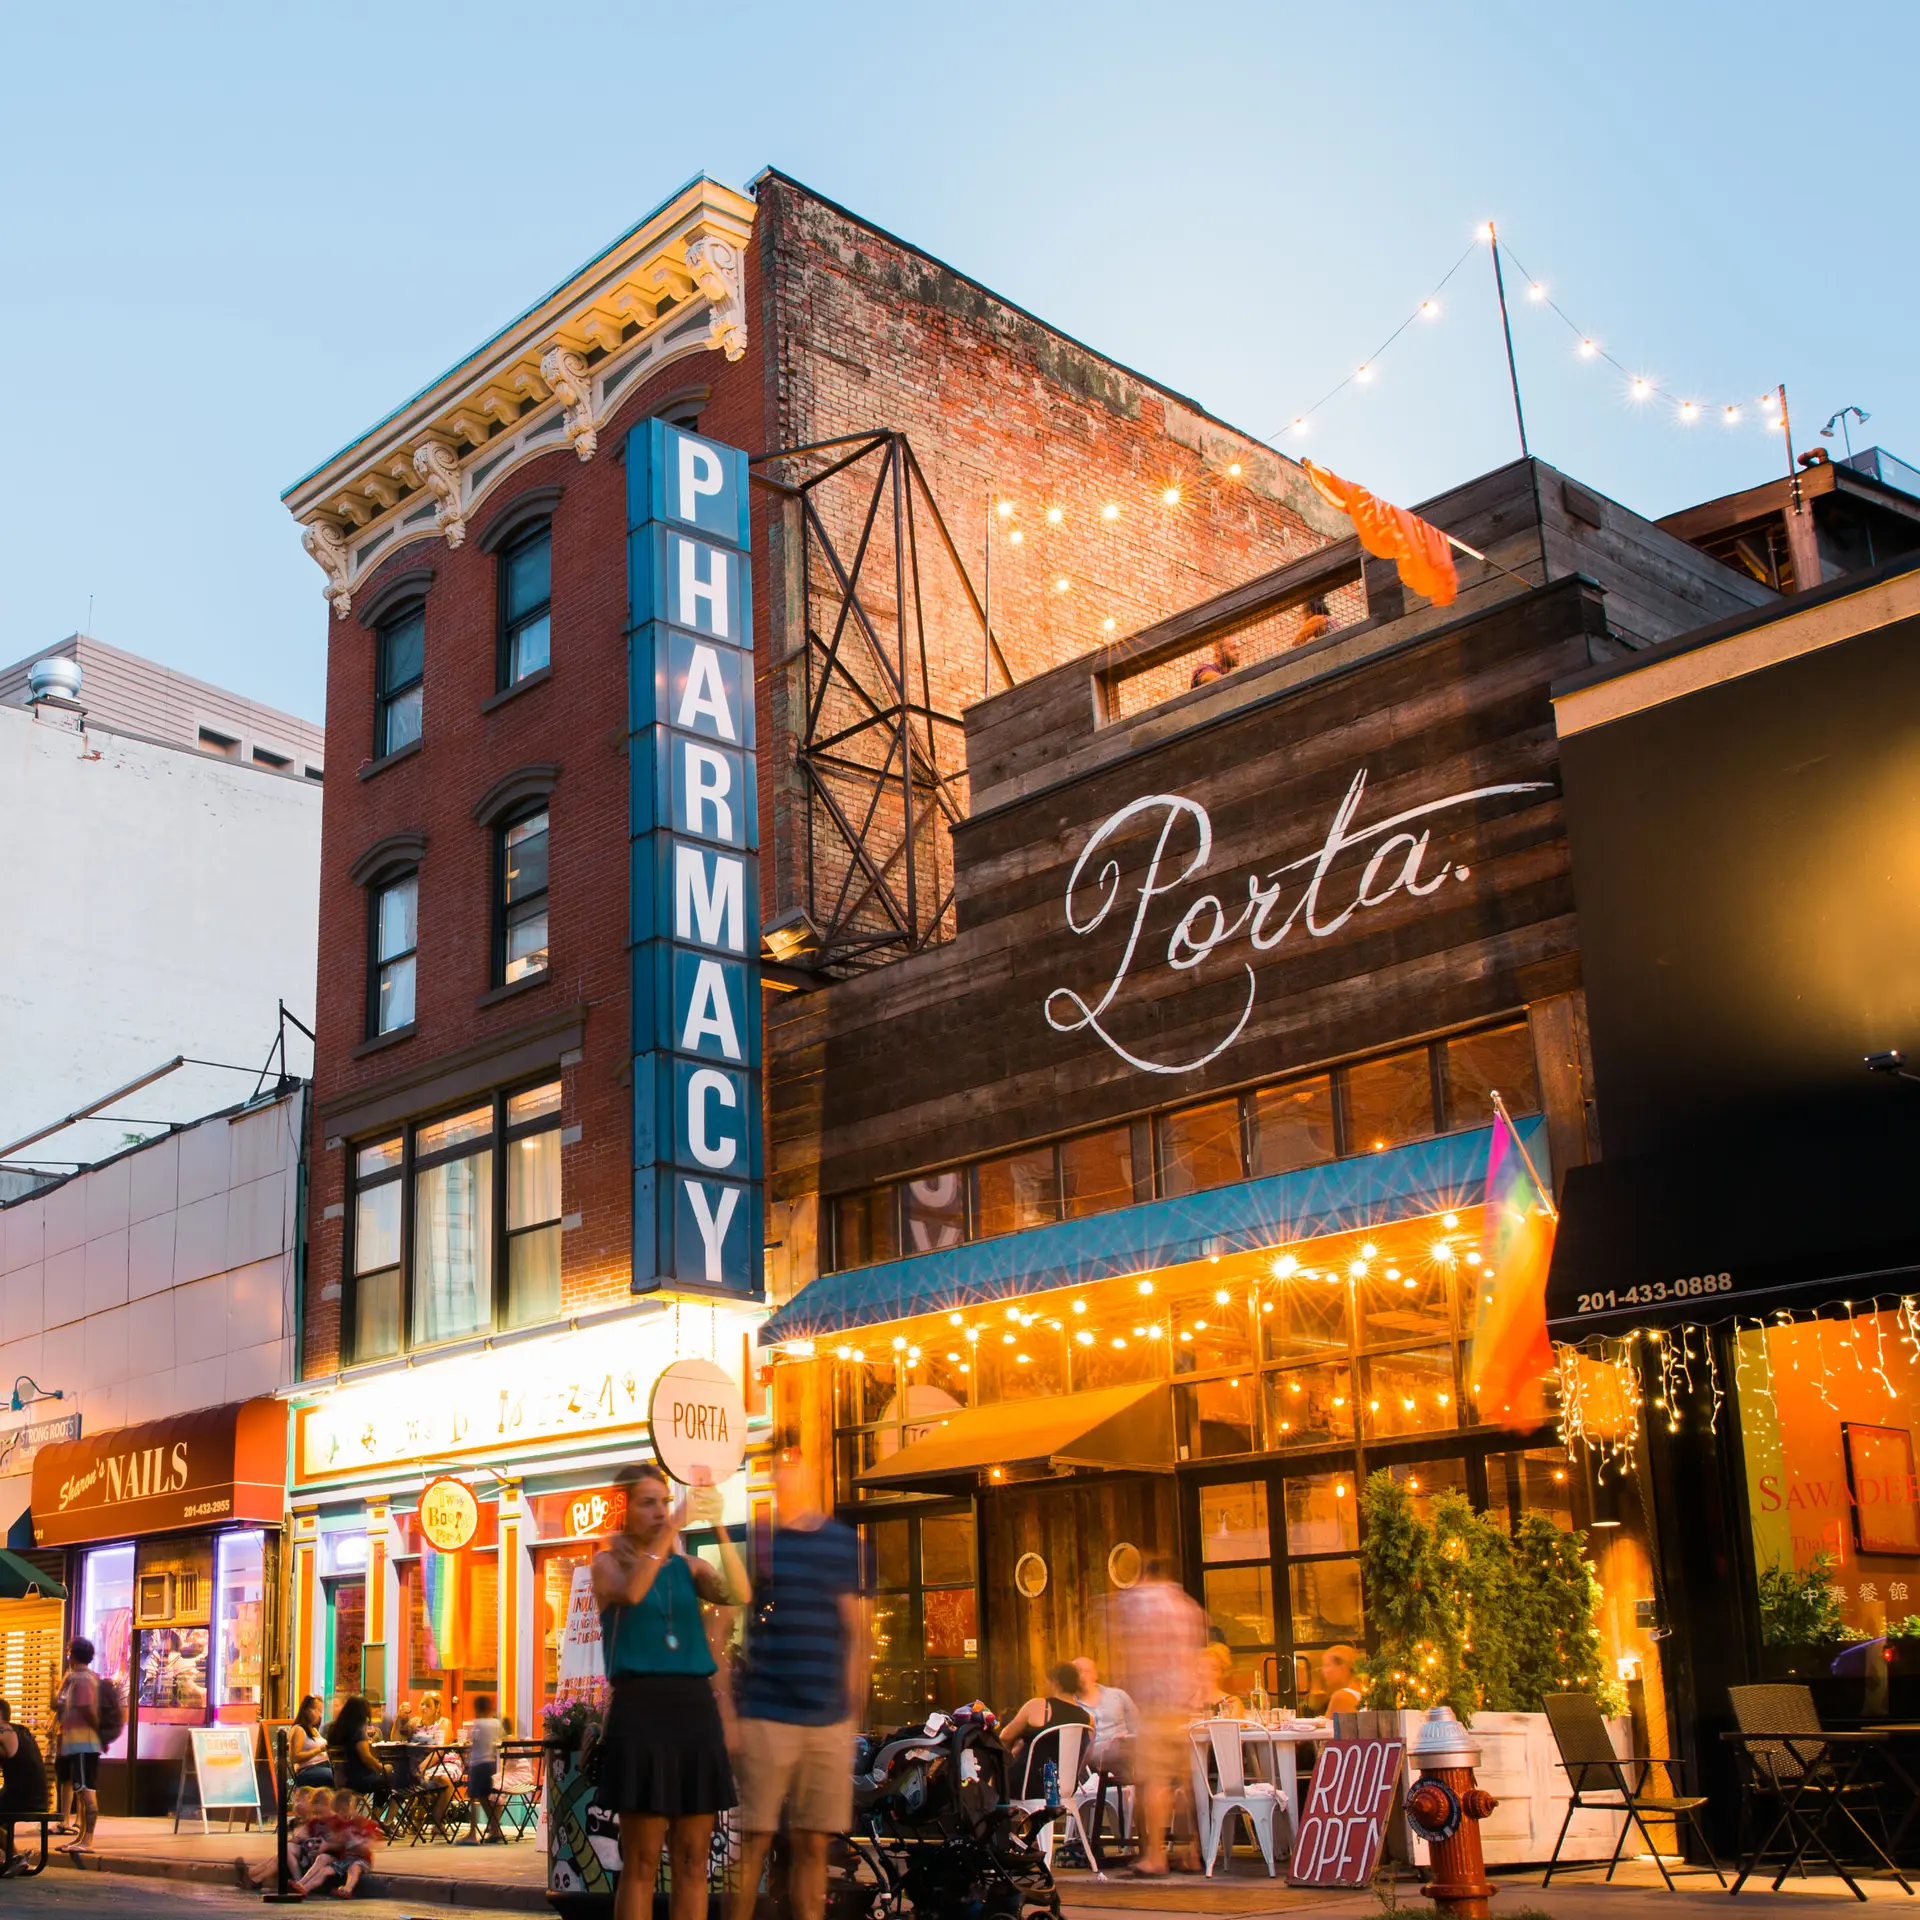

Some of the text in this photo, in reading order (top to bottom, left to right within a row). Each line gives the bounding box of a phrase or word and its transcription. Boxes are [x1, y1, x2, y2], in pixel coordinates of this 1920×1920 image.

[676, 436, 745, 1282] PHARMACY
[1577, 1272, 1733, 1313] 201-433-0888
[20, 1419, 74, 1446] STRONG ROOTS
[673, 1402, 729, 1443] PORTA
[58, 1441, 188, 1511] Sharon's NAILS
[183, 1499, 230, 1518] 201-432-2955
[1309, 1741, 1402, 1815] ROOF
